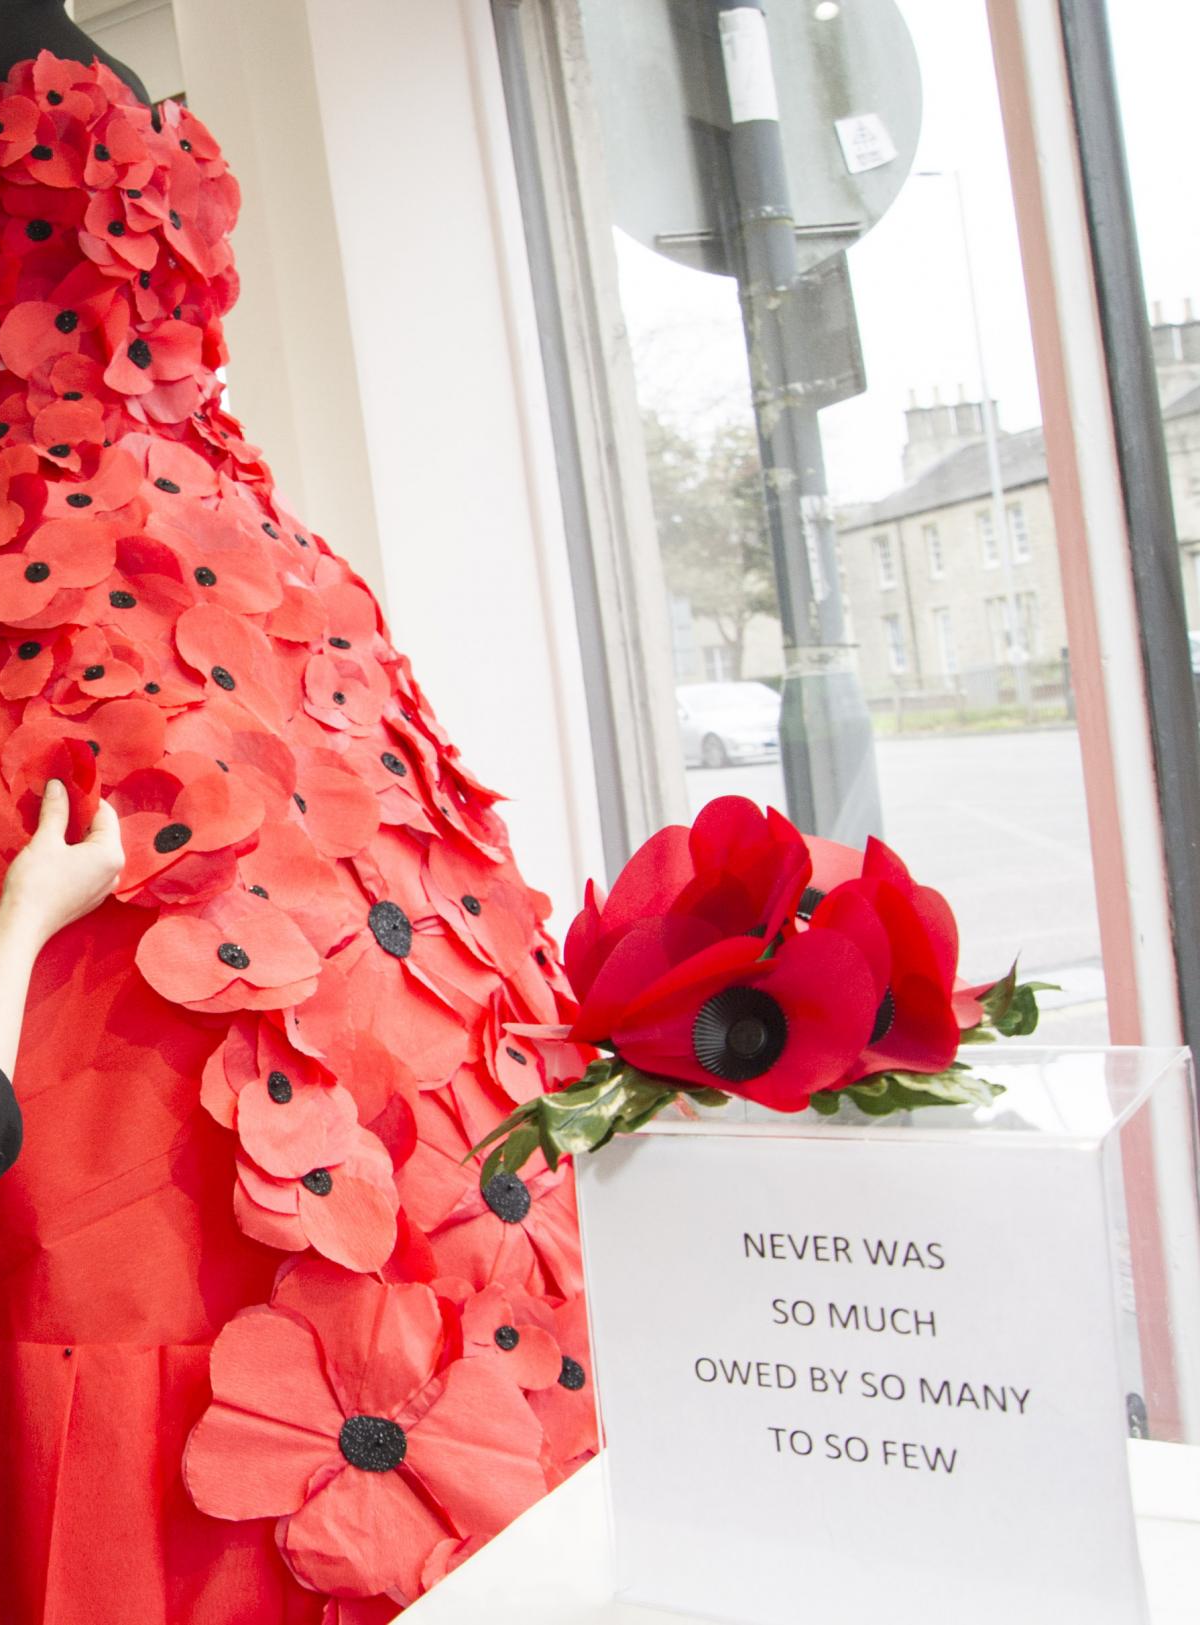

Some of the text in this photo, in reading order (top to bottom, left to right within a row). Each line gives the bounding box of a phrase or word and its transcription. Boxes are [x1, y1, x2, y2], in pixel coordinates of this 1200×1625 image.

[743, 1232, 946, 1270] NEVER WAS
[772, 1298, 936, 1336] SO MUCH
[695, 1357, 1030, 1414] OWED BY SO MANY
[768, 1427, 957, 1473] TO SO FEW
